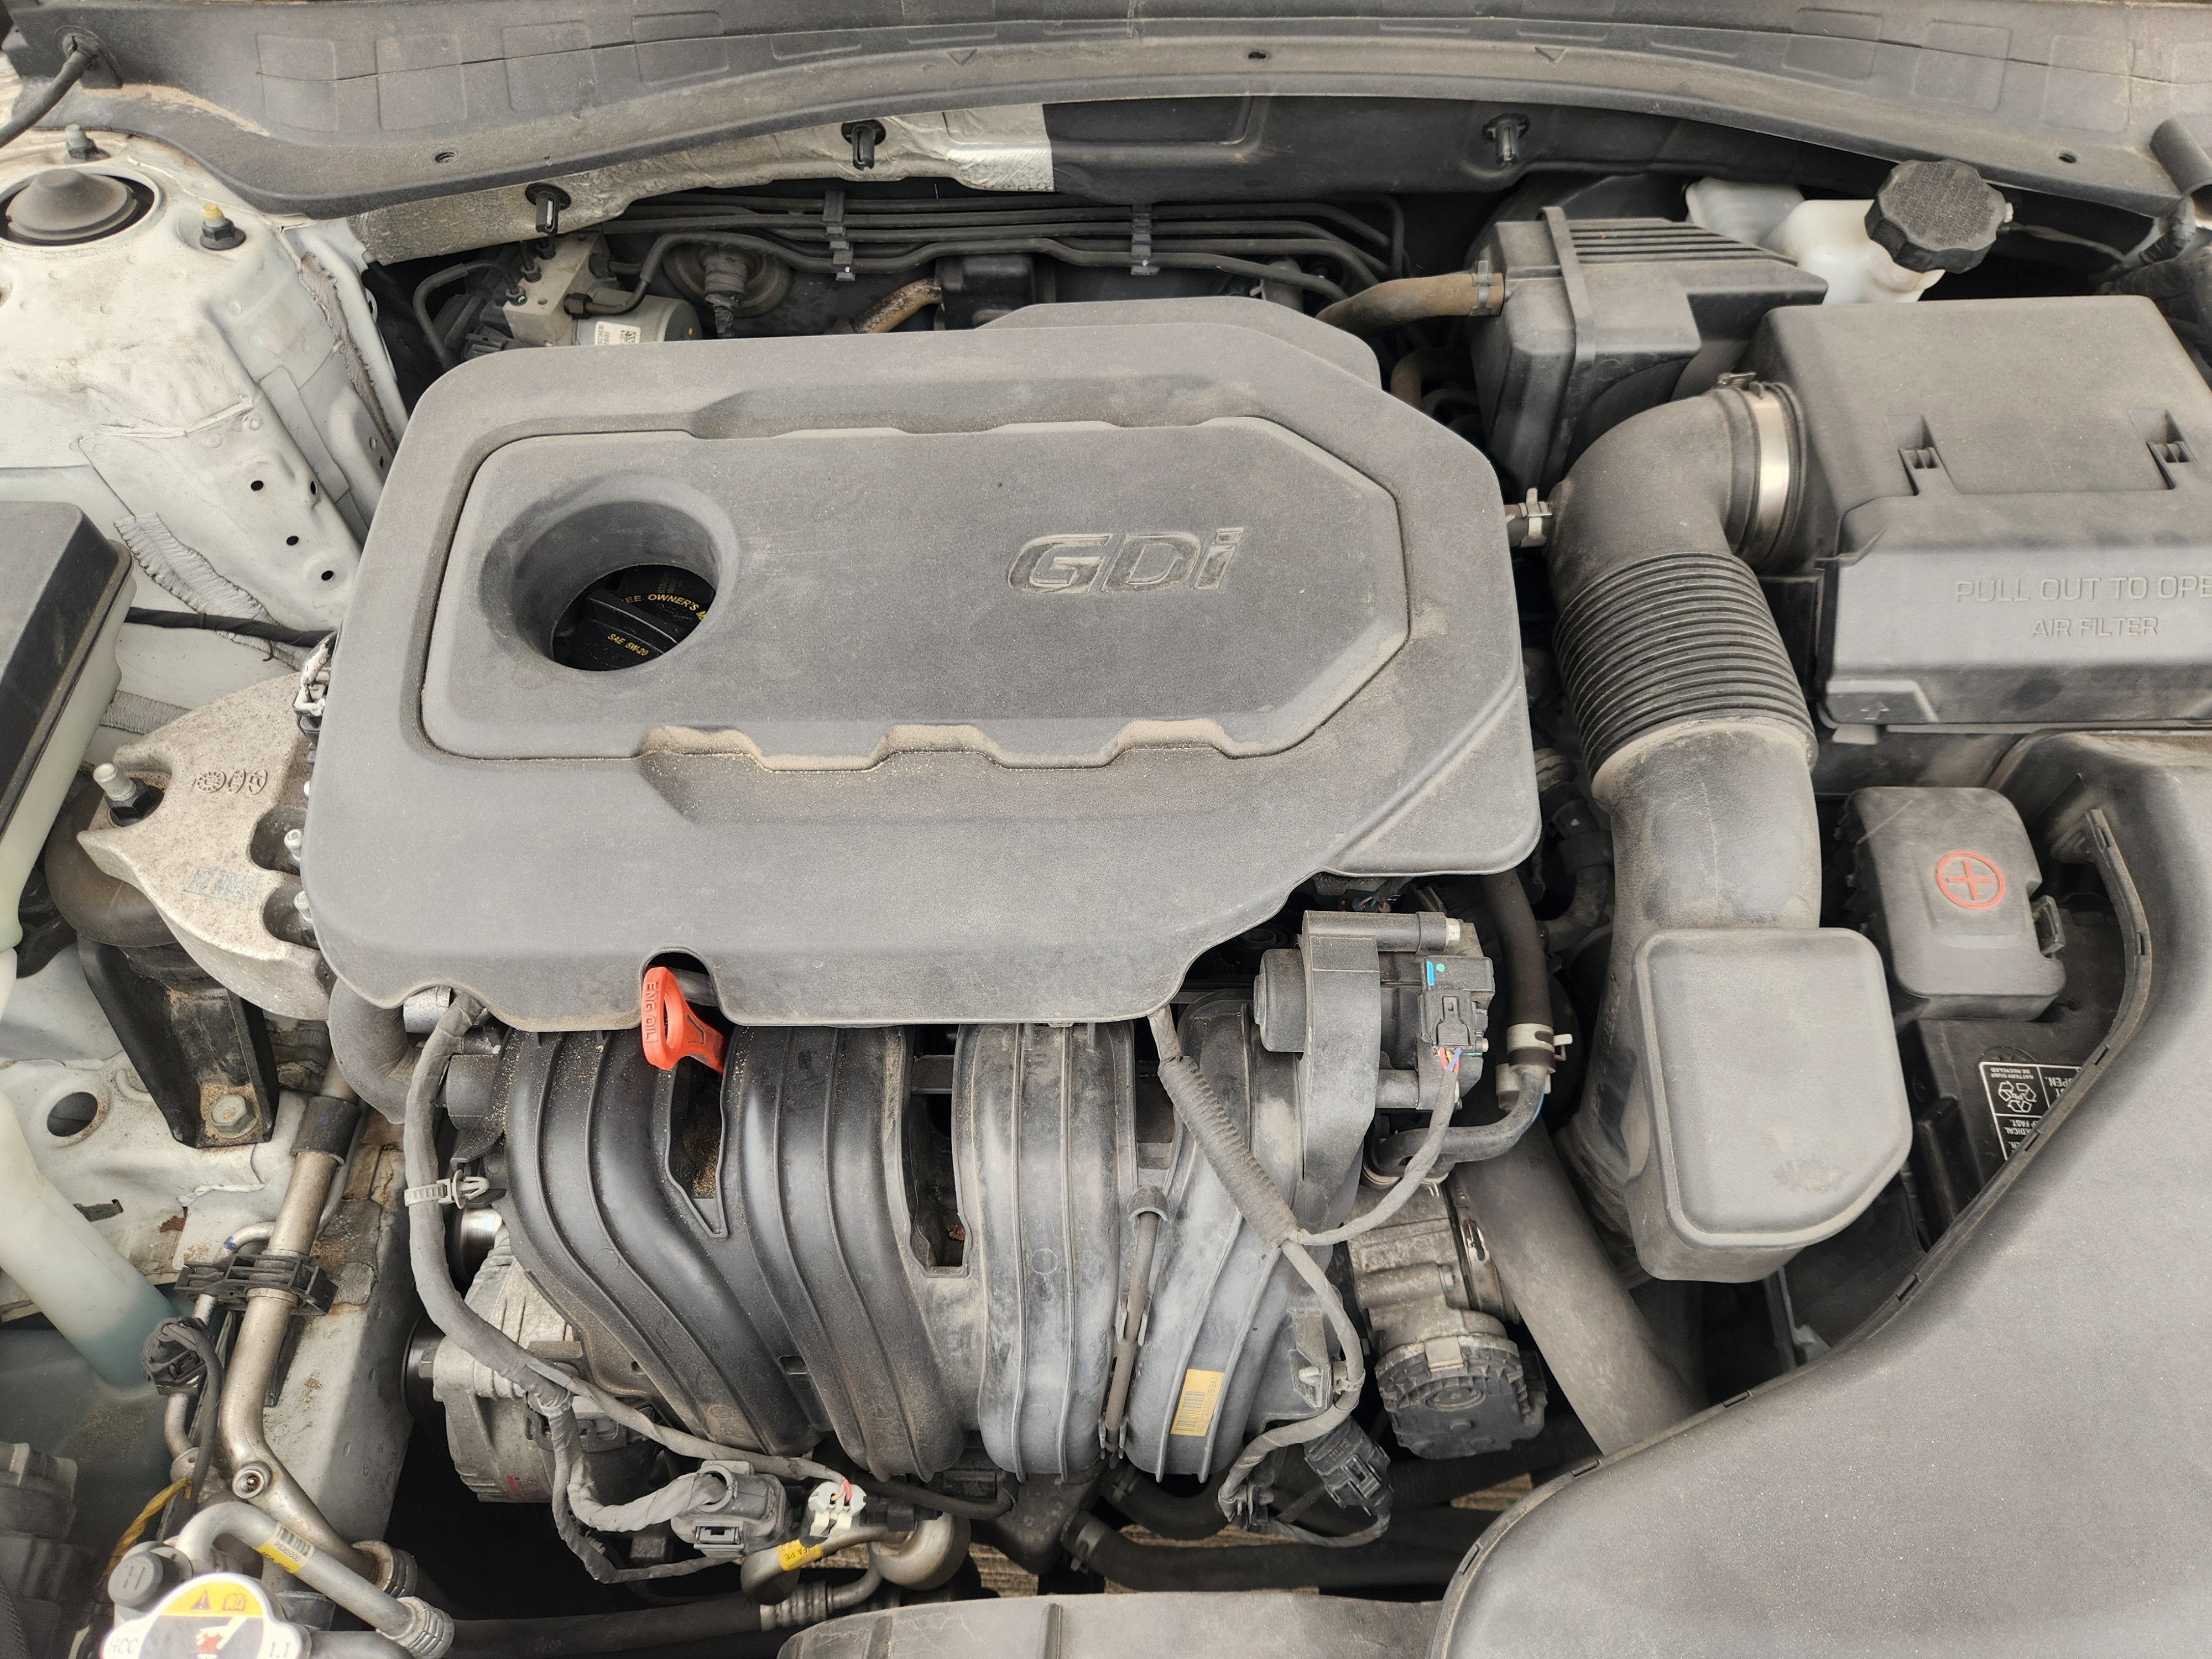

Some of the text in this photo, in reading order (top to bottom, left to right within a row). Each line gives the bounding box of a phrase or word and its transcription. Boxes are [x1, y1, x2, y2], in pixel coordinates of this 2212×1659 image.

[1007, 526, 1244, 593] GDi
[1957, 578, 2031, 603] PULL
[2039, 577, 2101, 601] OUT
[2109, 575, 2148, 600] TO
[625, 594, 700, 611] EE OWNER'S
[2032, 616, 2159, 638] AIR FILTER
[607, 633, 649, 657] SAE 5W-20
[644, 982, 658, 1041] ENG OIL
[2004, 1127, 2031, 1135] EDICAL
[123, 1565, 145, 1590] H
[109, 1637, 138, 1654] HCC
